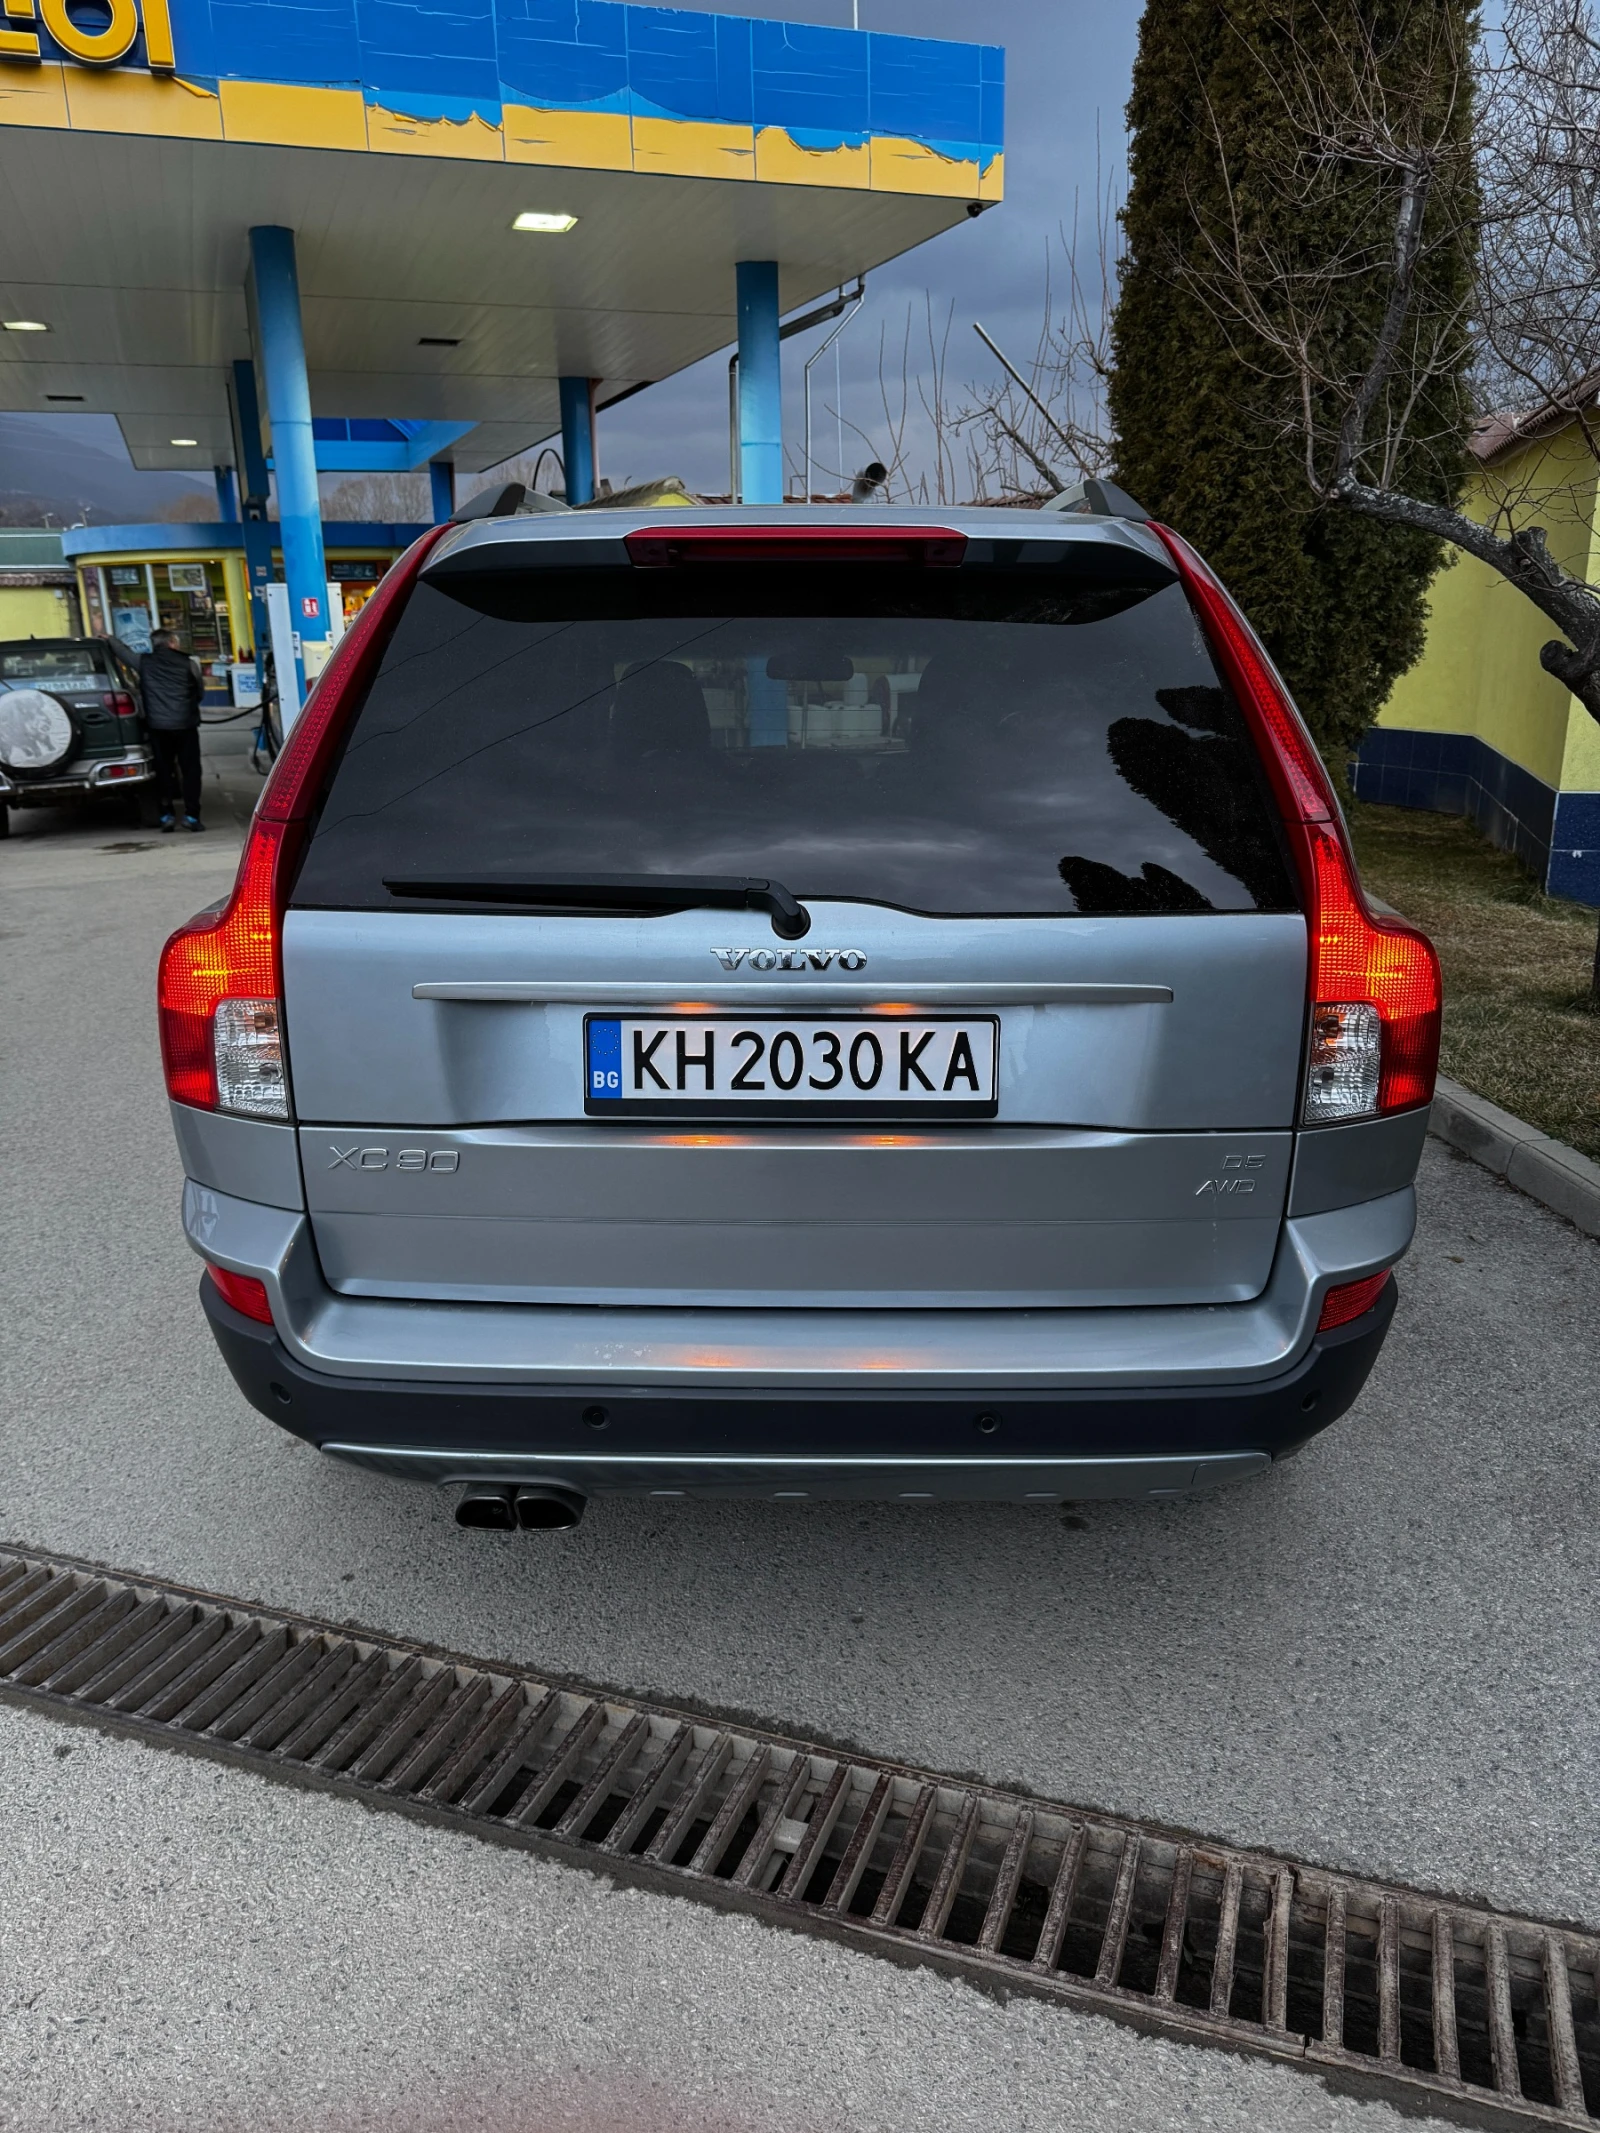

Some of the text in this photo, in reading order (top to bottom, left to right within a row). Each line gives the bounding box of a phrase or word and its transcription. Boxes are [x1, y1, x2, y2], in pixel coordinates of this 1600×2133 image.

[709, 947, 868, 971] VOLVO
[592, 1070, 619, 1089] BG
[1222, 1154, 1266, 1170] D5
[1194, 1178, 1256, 1195] AWD
